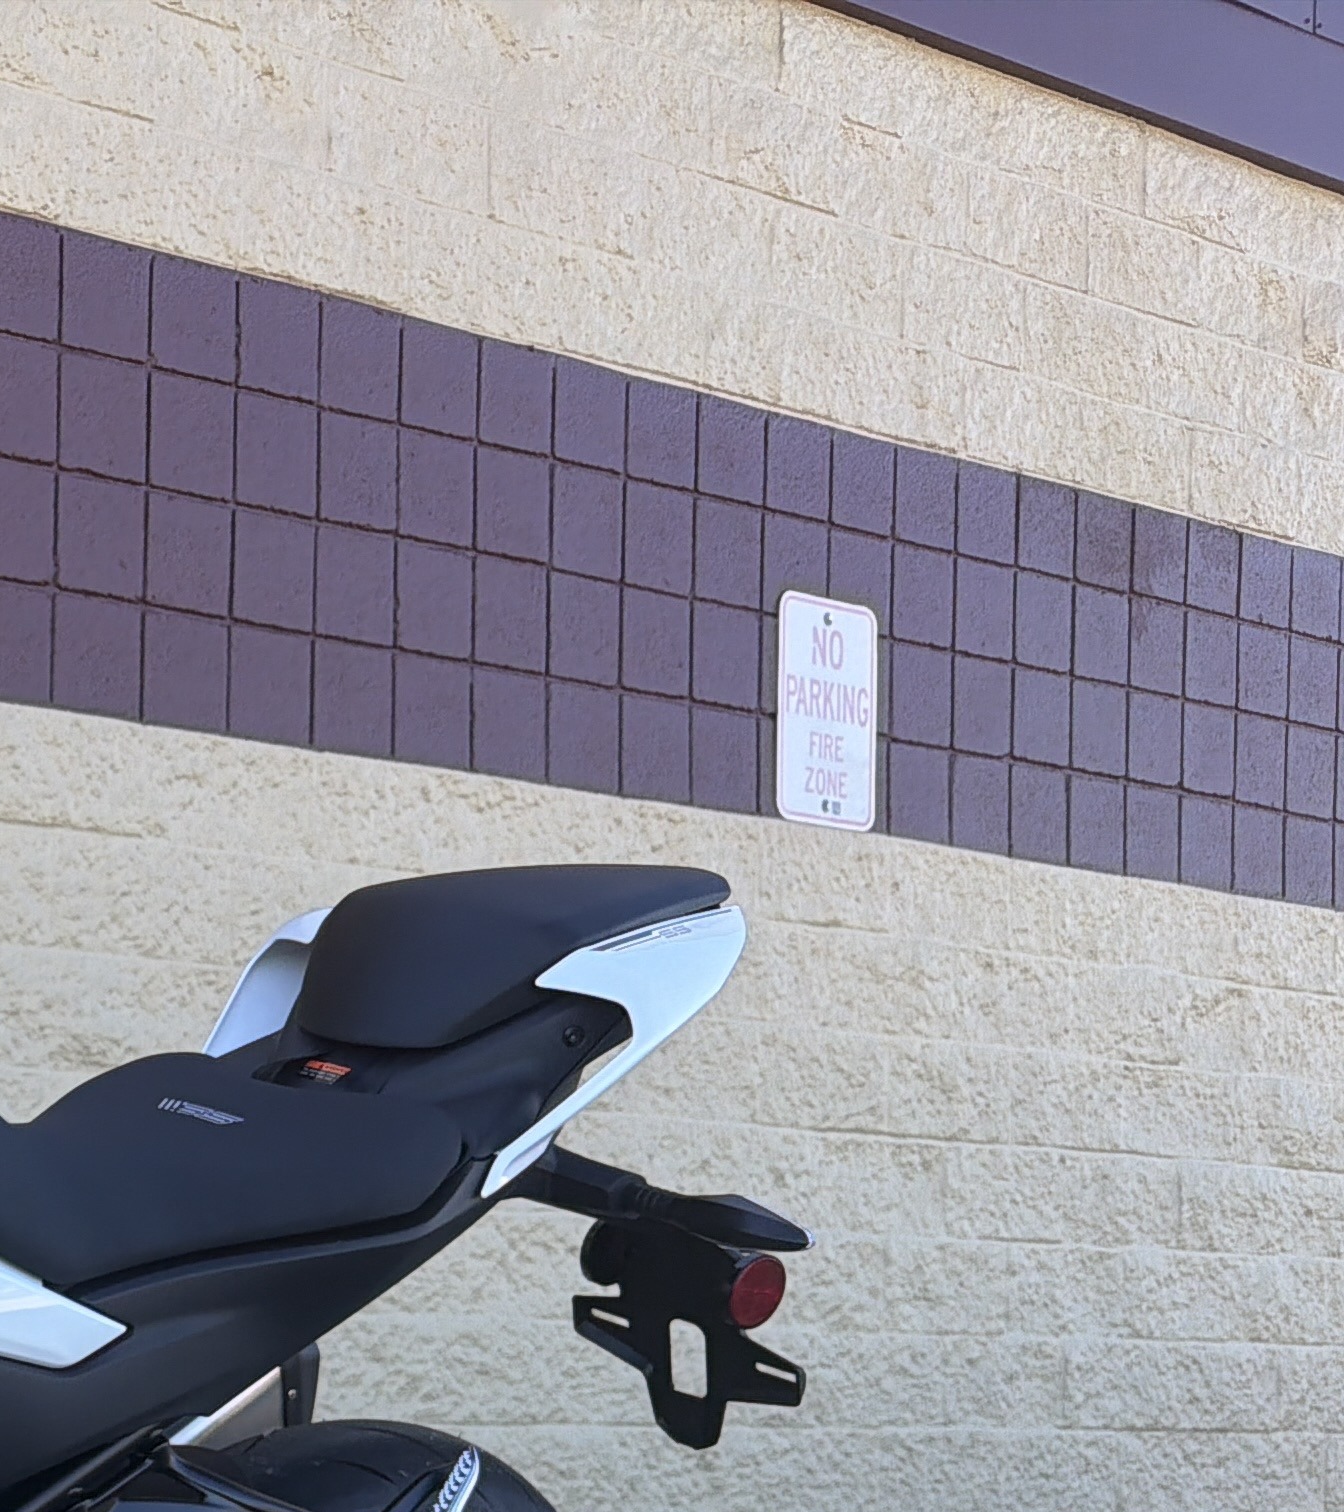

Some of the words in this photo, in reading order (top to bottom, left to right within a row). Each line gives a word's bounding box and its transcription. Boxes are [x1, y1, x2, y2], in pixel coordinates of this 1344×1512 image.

[812, 626, 844, 670] NO
[786, 674, 869, 728] PARKING
[809, 731, 844, 763] FIRE
[805, 766, 848, 799] ZONE
